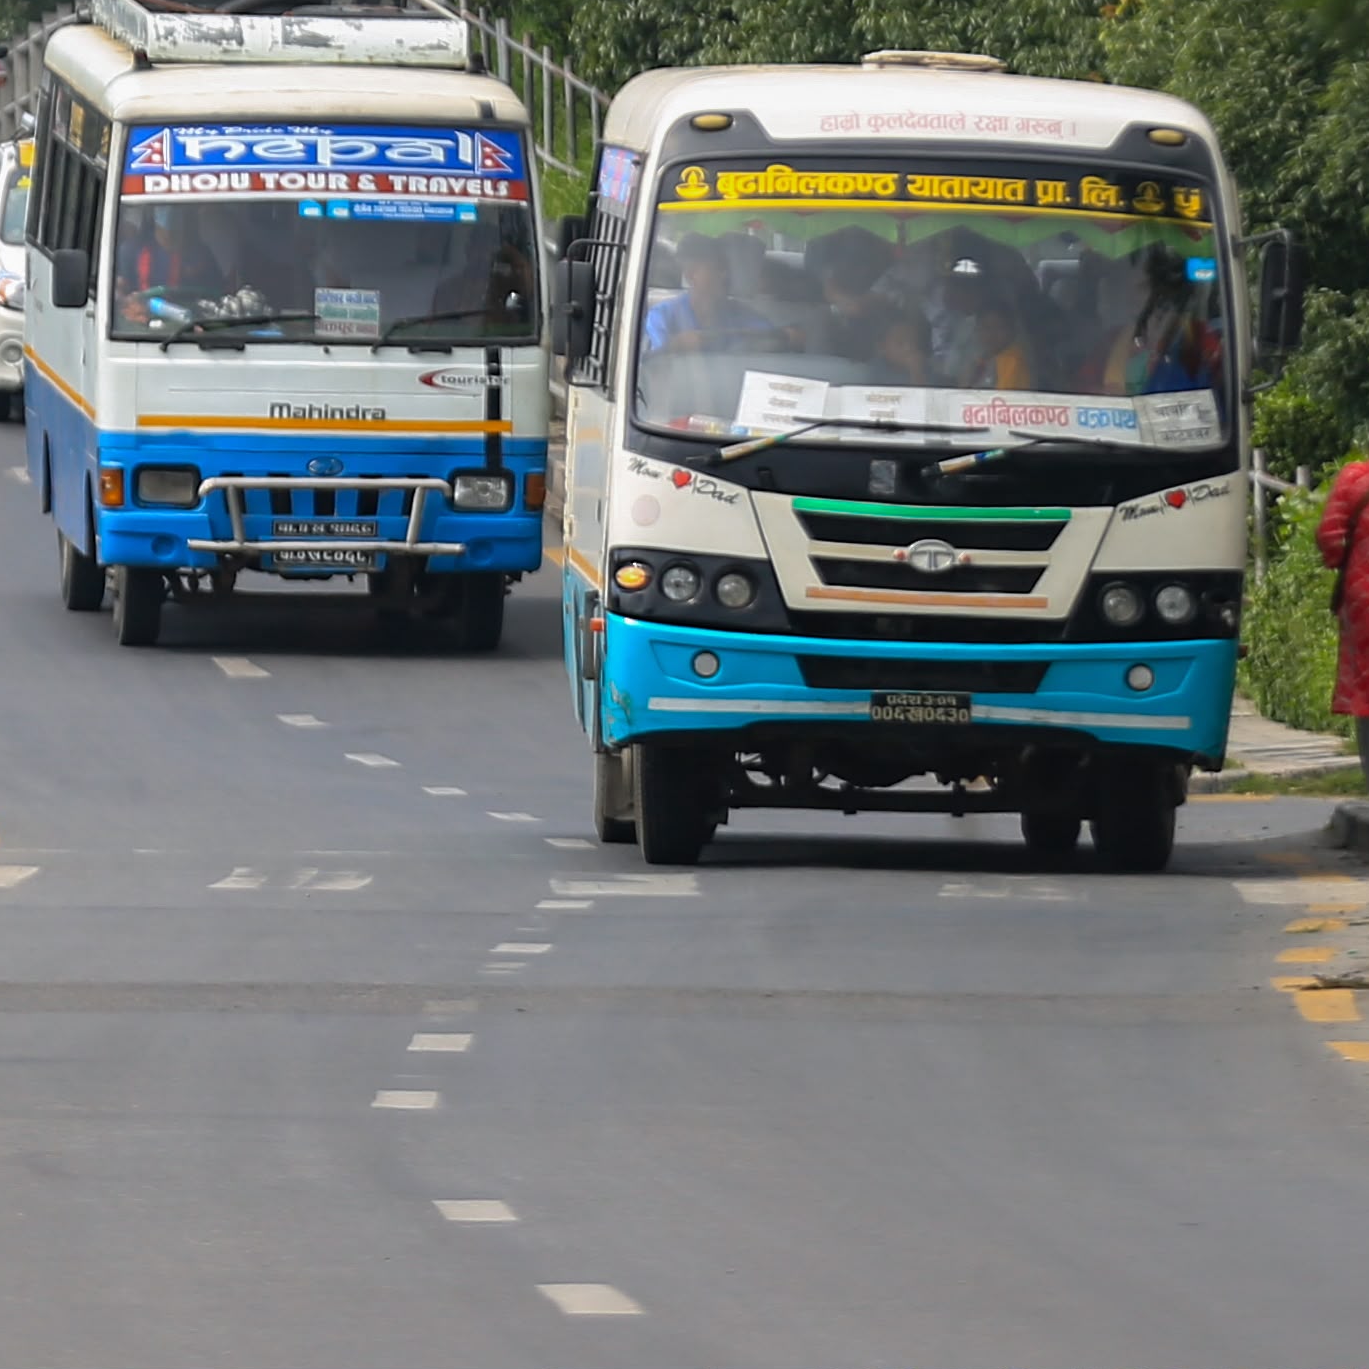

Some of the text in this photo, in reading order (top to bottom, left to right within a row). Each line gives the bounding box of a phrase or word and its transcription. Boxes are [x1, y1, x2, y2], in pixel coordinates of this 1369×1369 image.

[176, 130, 473, 167] nepal
[144, 173, 509, 197] DHOJU TOUR & TRAVELS
[906, 175, 1027, 201] यातायात
[269, 402, 386, 421] Mahindra
